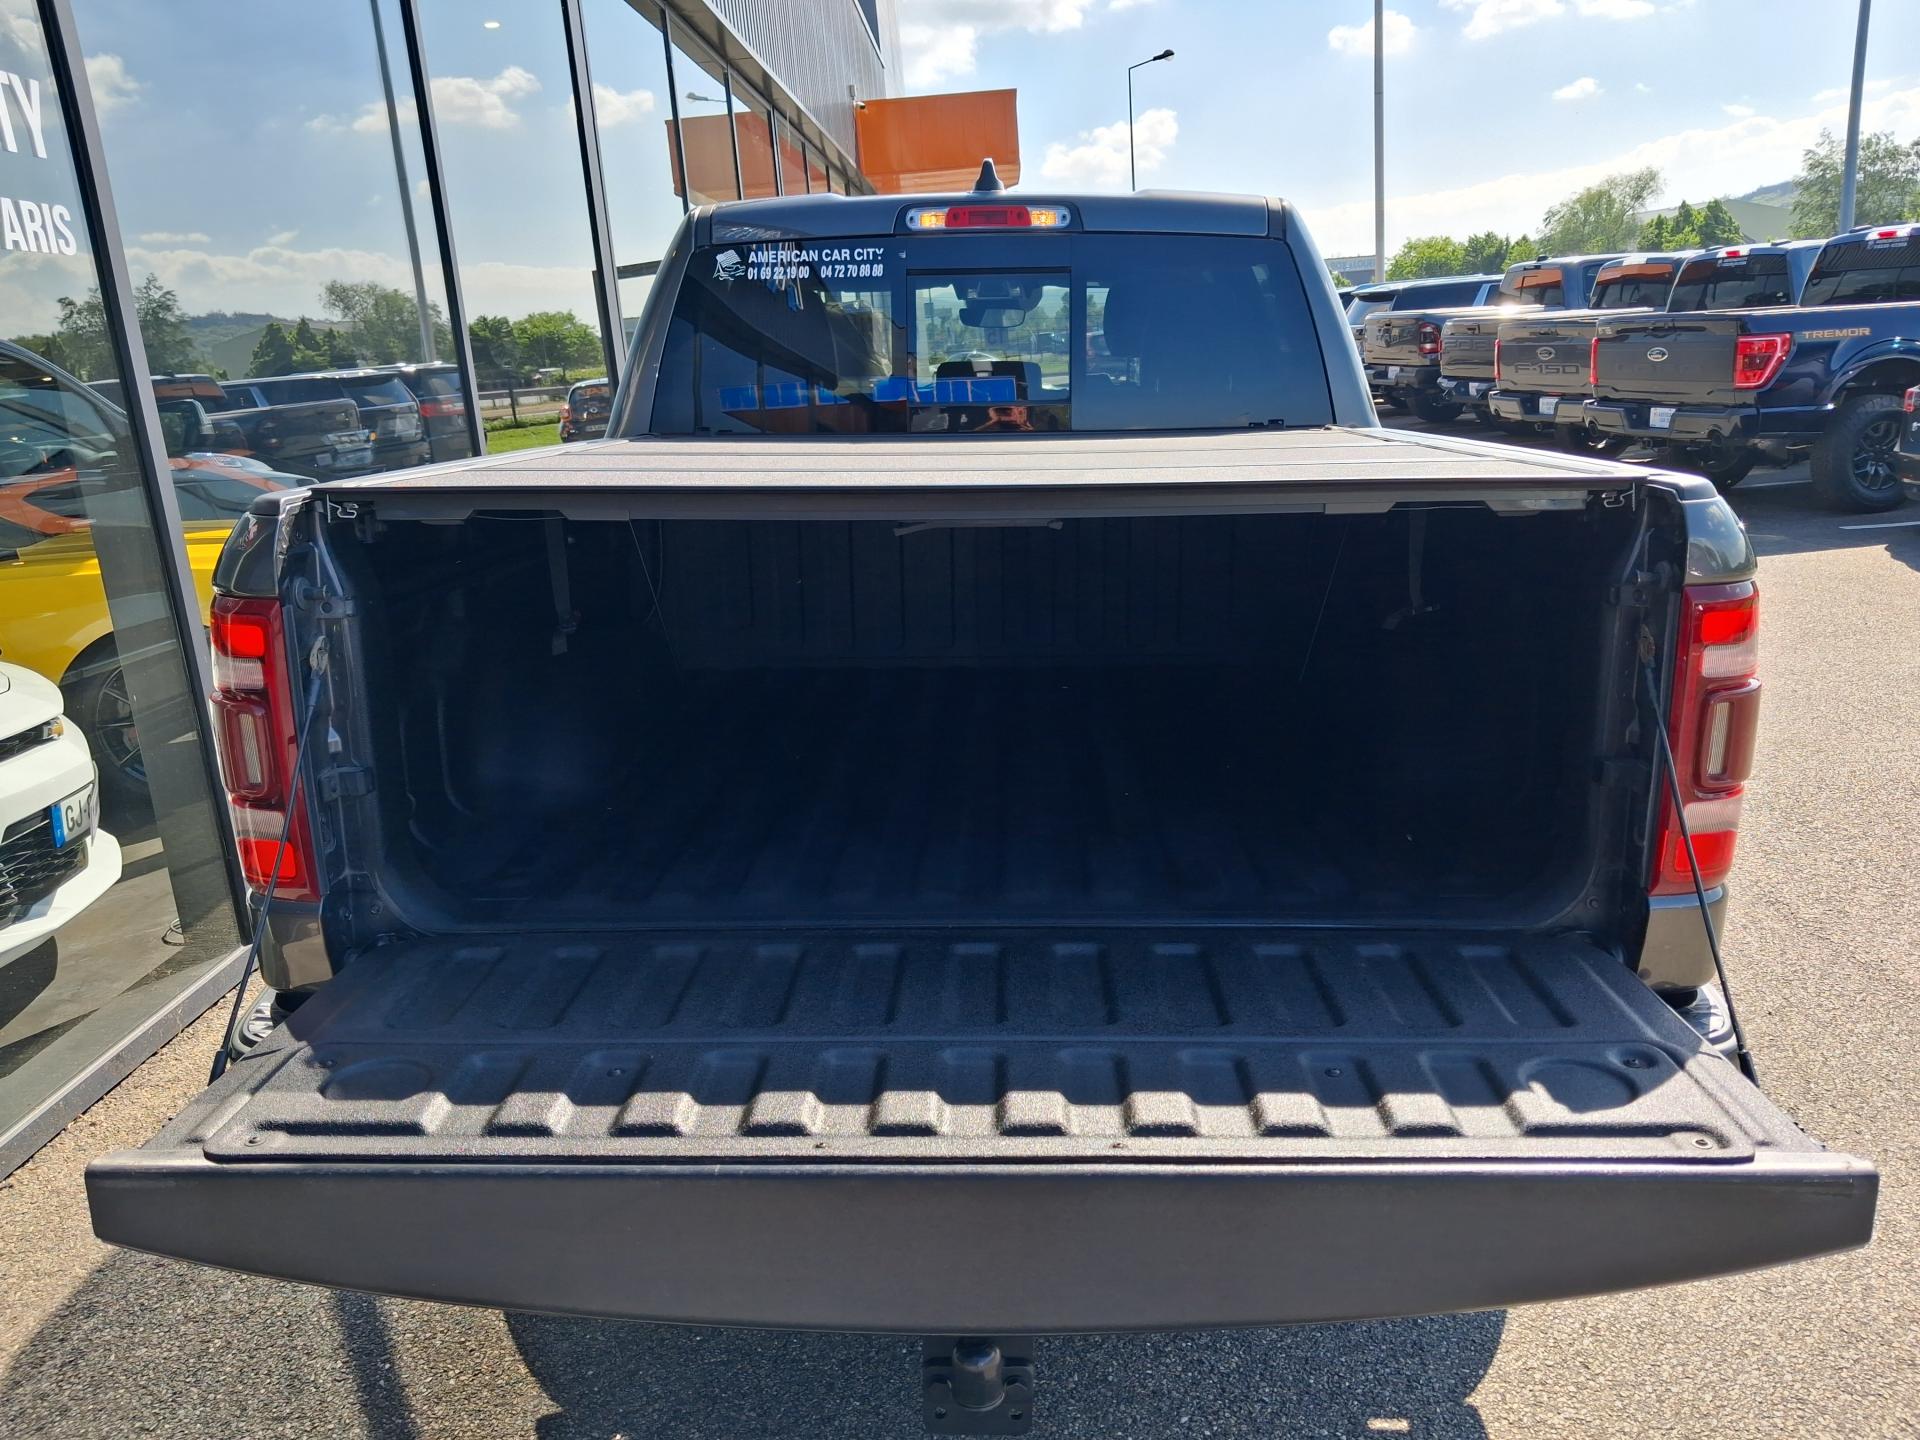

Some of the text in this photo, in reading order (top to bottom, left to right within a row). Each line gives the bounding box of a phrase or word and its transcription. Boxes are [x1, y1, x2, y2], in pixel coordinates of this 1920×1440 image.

[748, 247, 884, 263] AMERICAN CAR CITY
[747, 267, 758, 280] 01
[760, 266, 771, 280] 69
[773, 266, 784, 280] 22
[786, 266, 796, 279] 19
[798, 265, 810, 279] 00
[821, 264, 832, 278] 04
[834, 264, 845, 278] 72
[847, 264, 858, 278] 70
[1802, 327, 1871, 339] TREMOR
[1514, 362, 1581, 375] F-150
